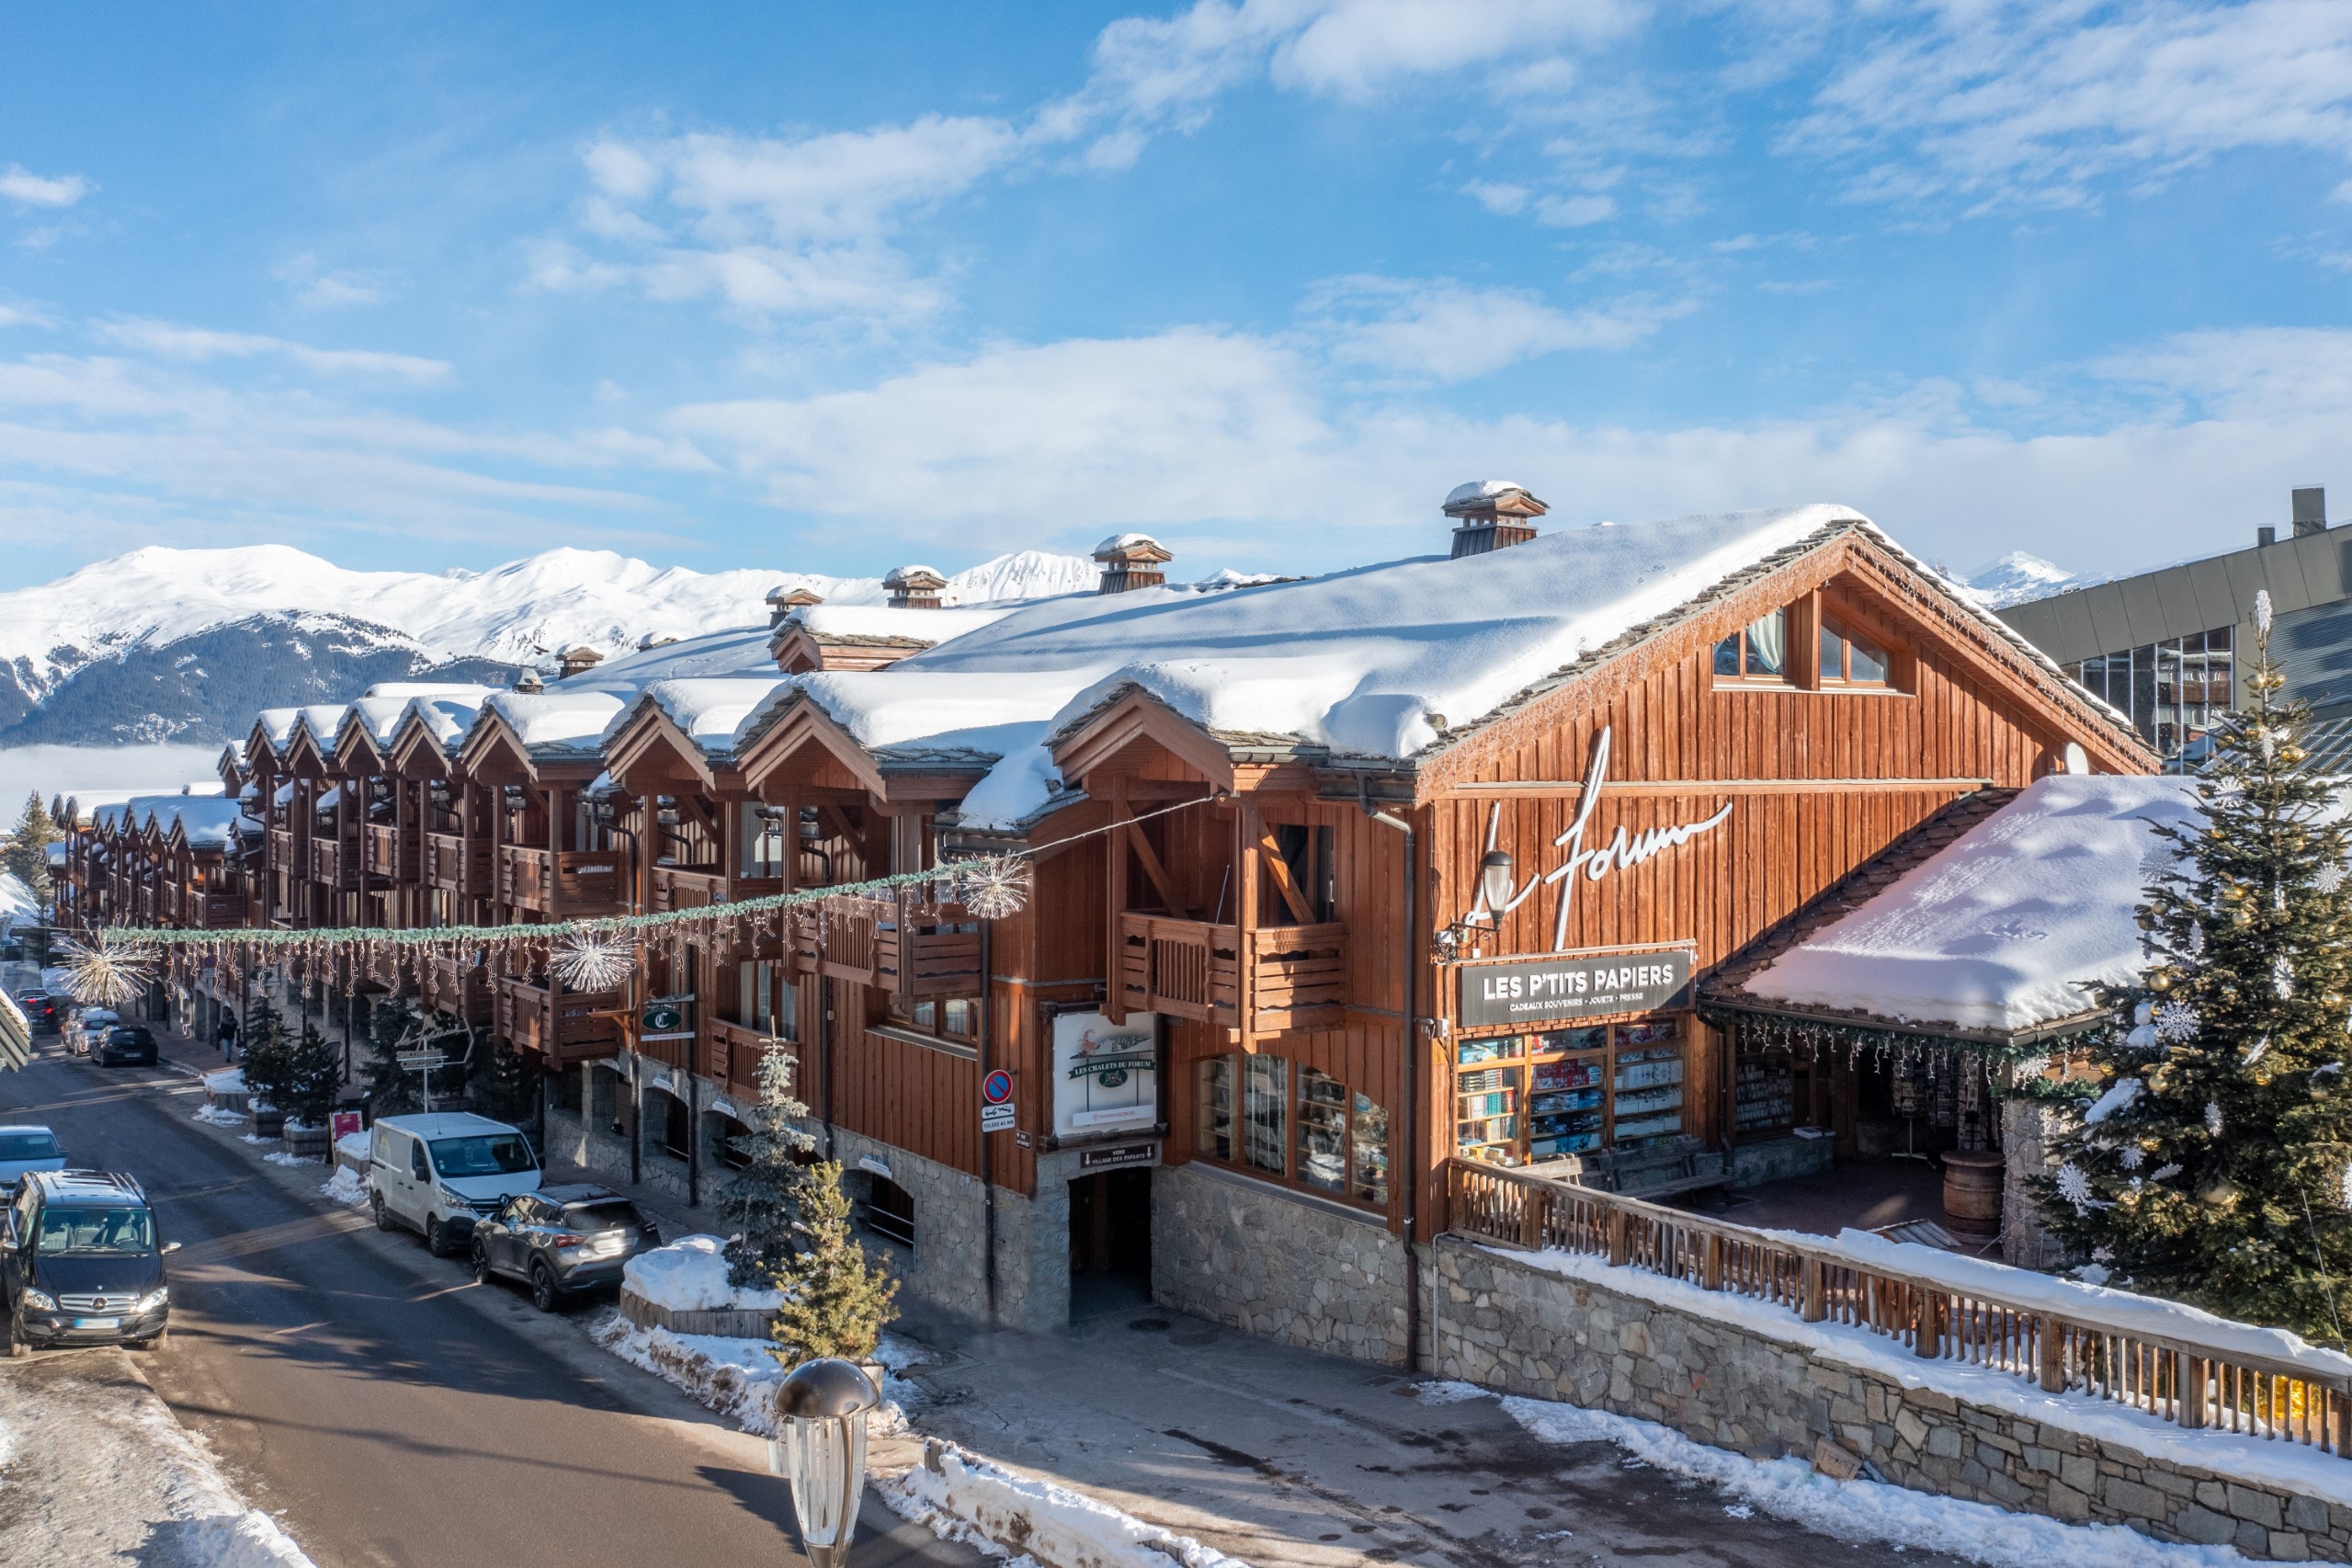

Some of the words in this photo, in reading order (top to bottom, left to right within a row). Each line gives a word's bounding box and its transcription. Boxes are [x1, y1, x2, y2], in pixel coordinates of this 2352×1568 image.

[1543, 725, 1733, 952] Forum
[1483, 975, 1523, 1000] LES
[1528, 971, 1587, 996] P'TITS
[1594, 964, 1675, 990] PAPIERS
[1509, 1001, 1544, 1012] CADEAUX
[1544, 998, 1584, 1009] SOUVENIRS
[1588, 994, 1614, 1006] JOUETS
[1619, 992, 1644, 1002] PRESSE
[1074, 1067, 1087, 1075] LES
[1087, 1062, 1118, 1073] CHALETS
[1092, 1156, 1112, 1165] VILLAGE
